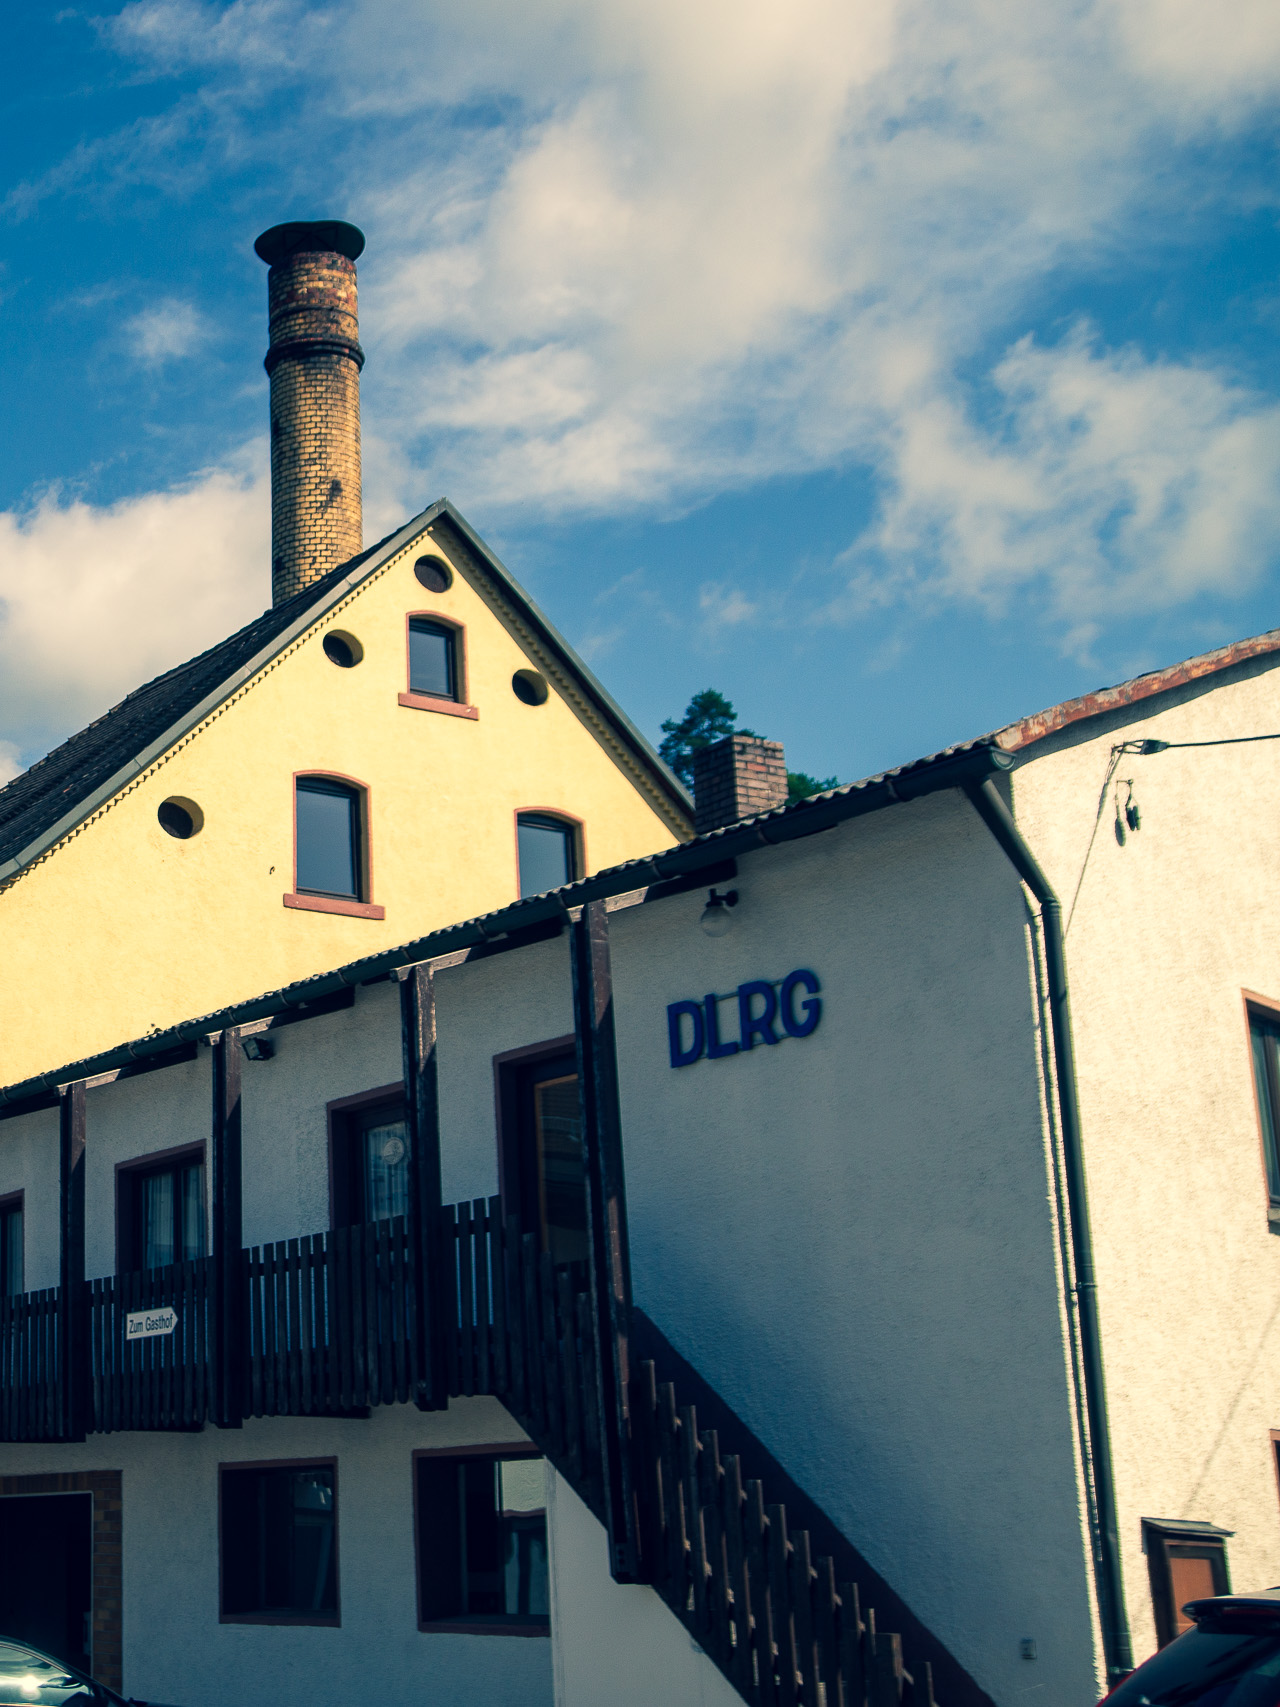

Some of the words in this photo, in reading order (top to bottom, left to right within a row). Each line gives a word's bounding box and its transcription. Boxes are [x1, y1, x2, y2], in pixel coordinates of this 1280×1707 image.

[667, 969, 821, 1068] DLRG
[129, 1320, 144, 1334] Zum
[145, 1313, 174, 1332] Gasthof
